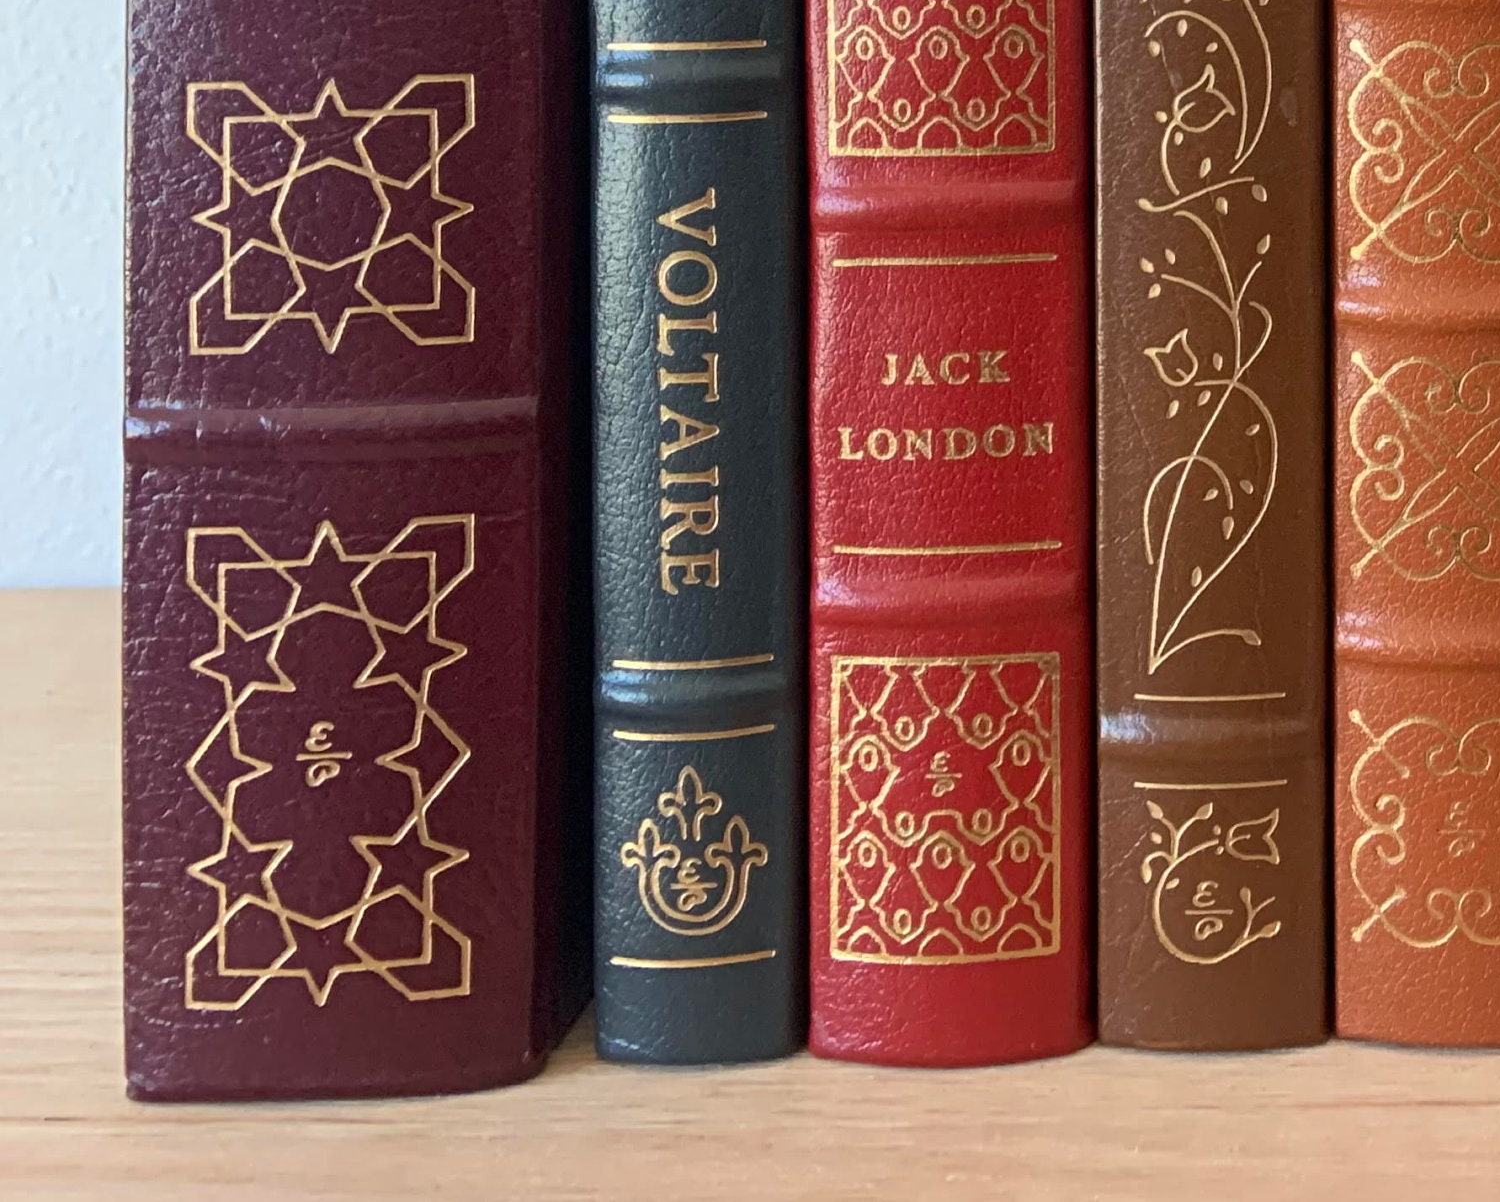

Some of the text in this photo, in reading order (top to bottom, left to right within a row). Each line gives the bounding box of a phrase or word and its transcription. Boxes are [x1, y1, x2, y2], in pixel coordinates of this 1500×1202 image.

[881, 350, 1011, 386] JACK
[655, 186, 720, 596] VOLTAIRE
[837, 421, 1054, 461] LONDON
